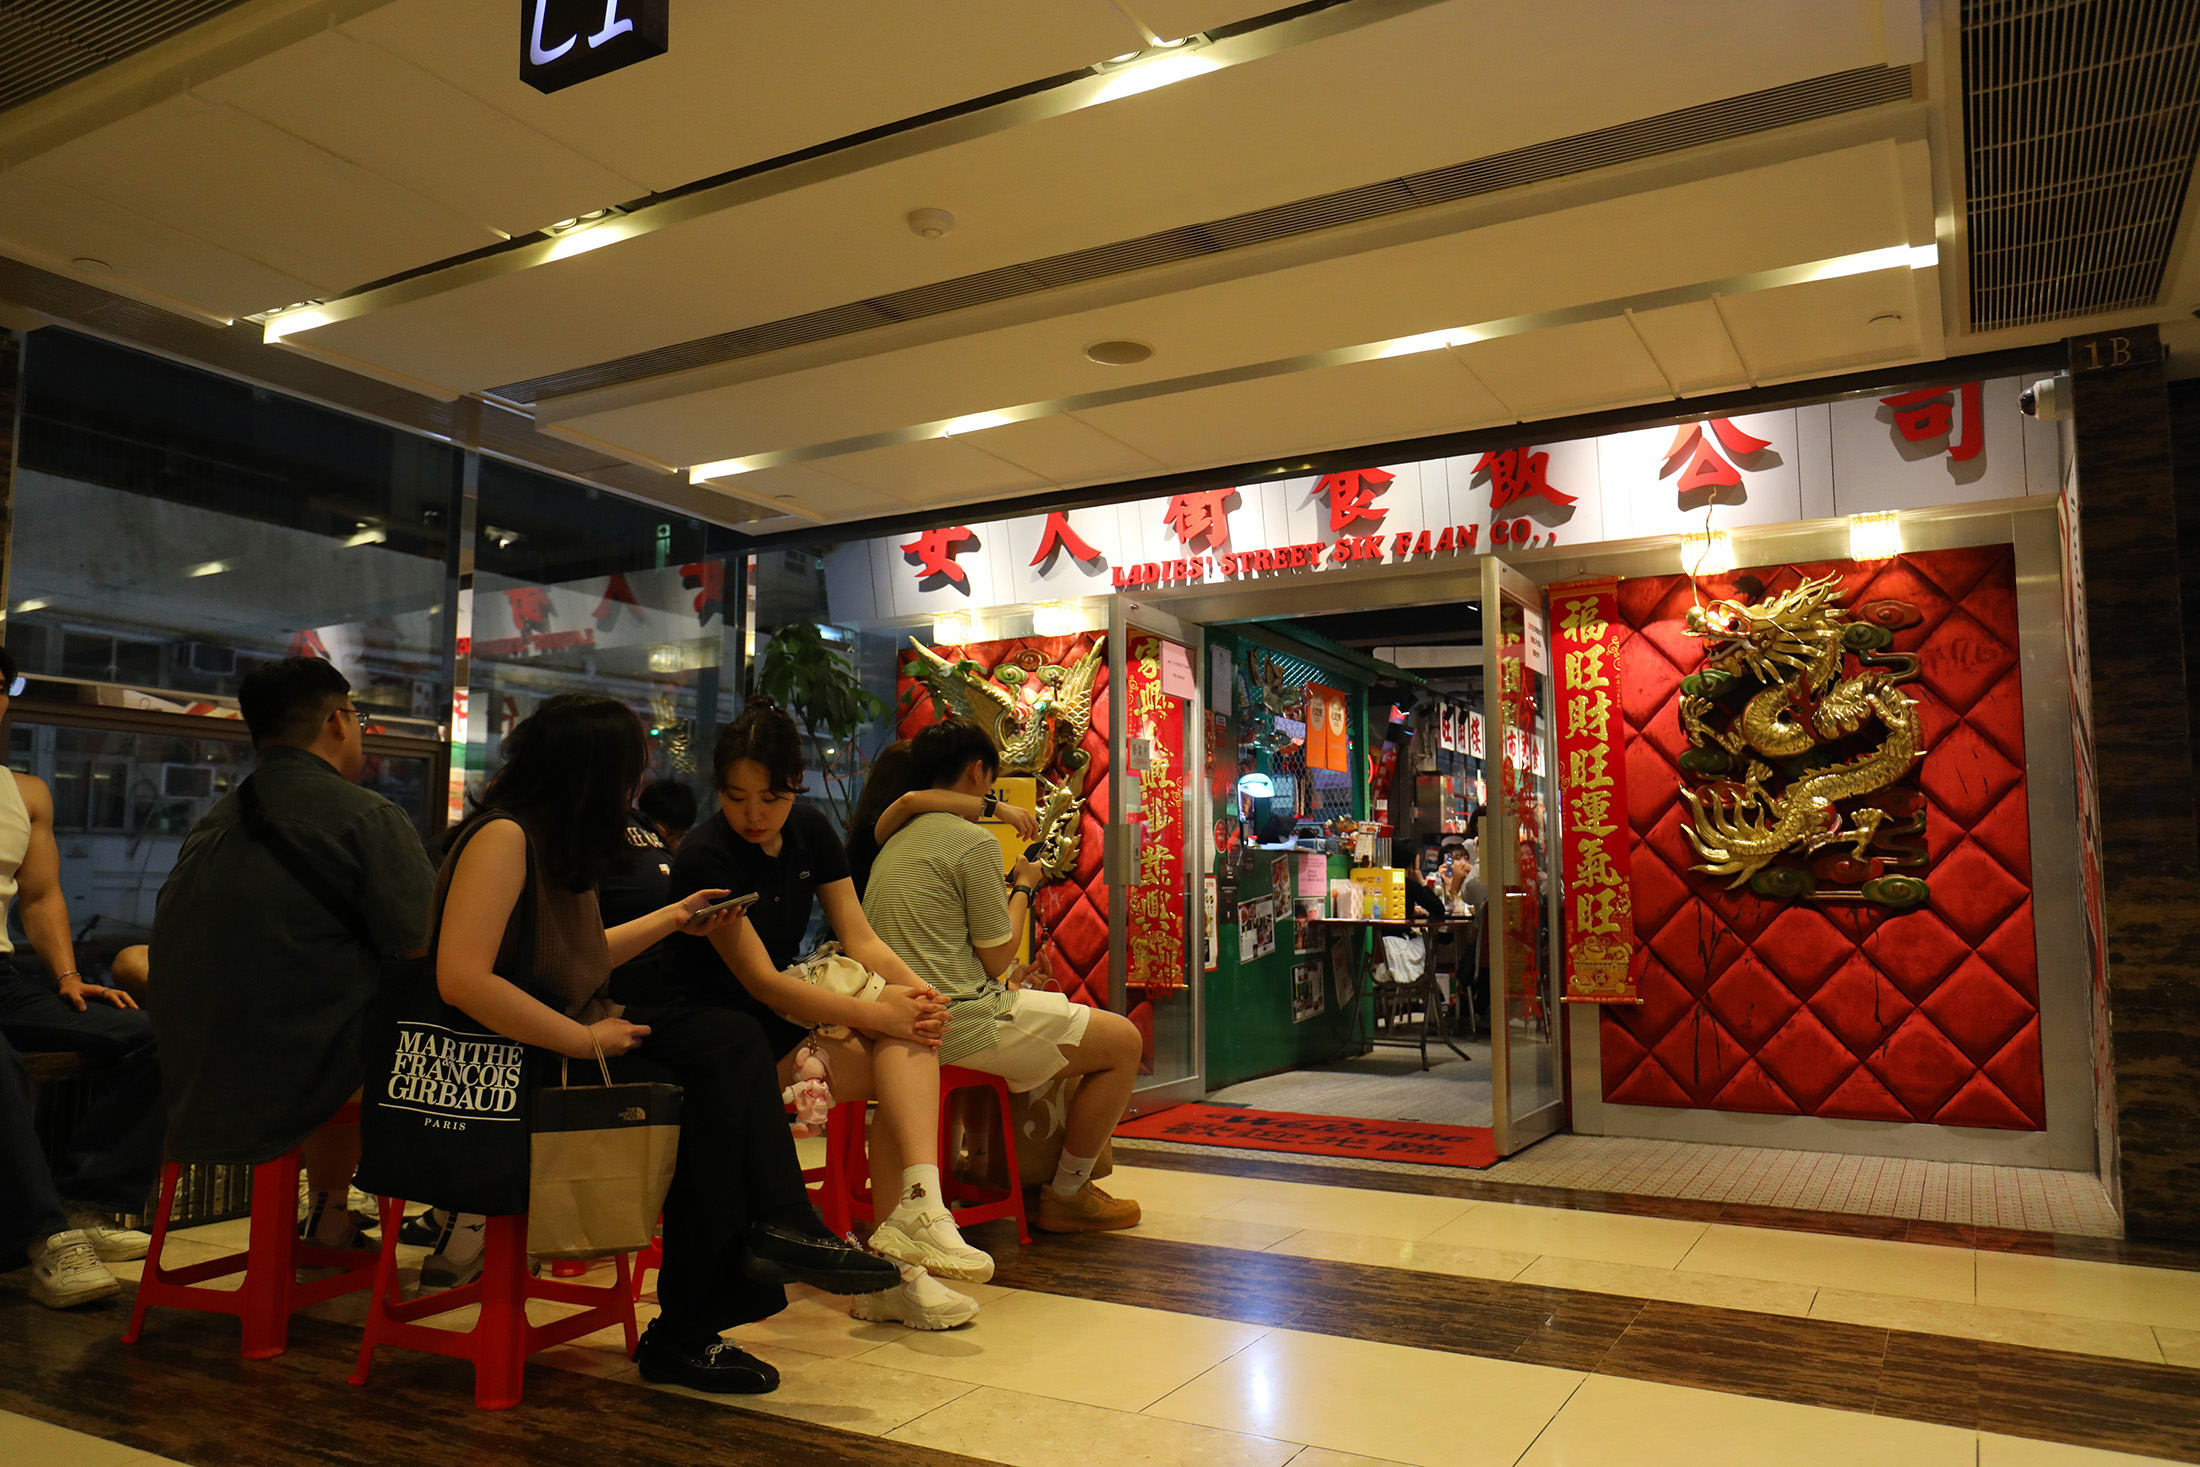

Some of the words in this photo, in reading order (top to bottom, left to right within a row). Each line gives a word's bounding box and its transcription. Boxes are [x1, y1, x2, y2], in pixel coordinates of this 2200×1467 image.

[1111, 556, 1213, 587] LADIES'
[1220, 542, 1325, 575] STREET
[1333, 535, 1386, 562] SIK
[1395, 523, 1479, 555] FAAN
[1559, 595, 1622, 936] 福旺財旺運氣旺
[396, 1030, 524, 1067] MARITHÉ
[388, 1074, 517, 1112] GIRBAUD
[424, 1117, 466, 1131] PARIS
